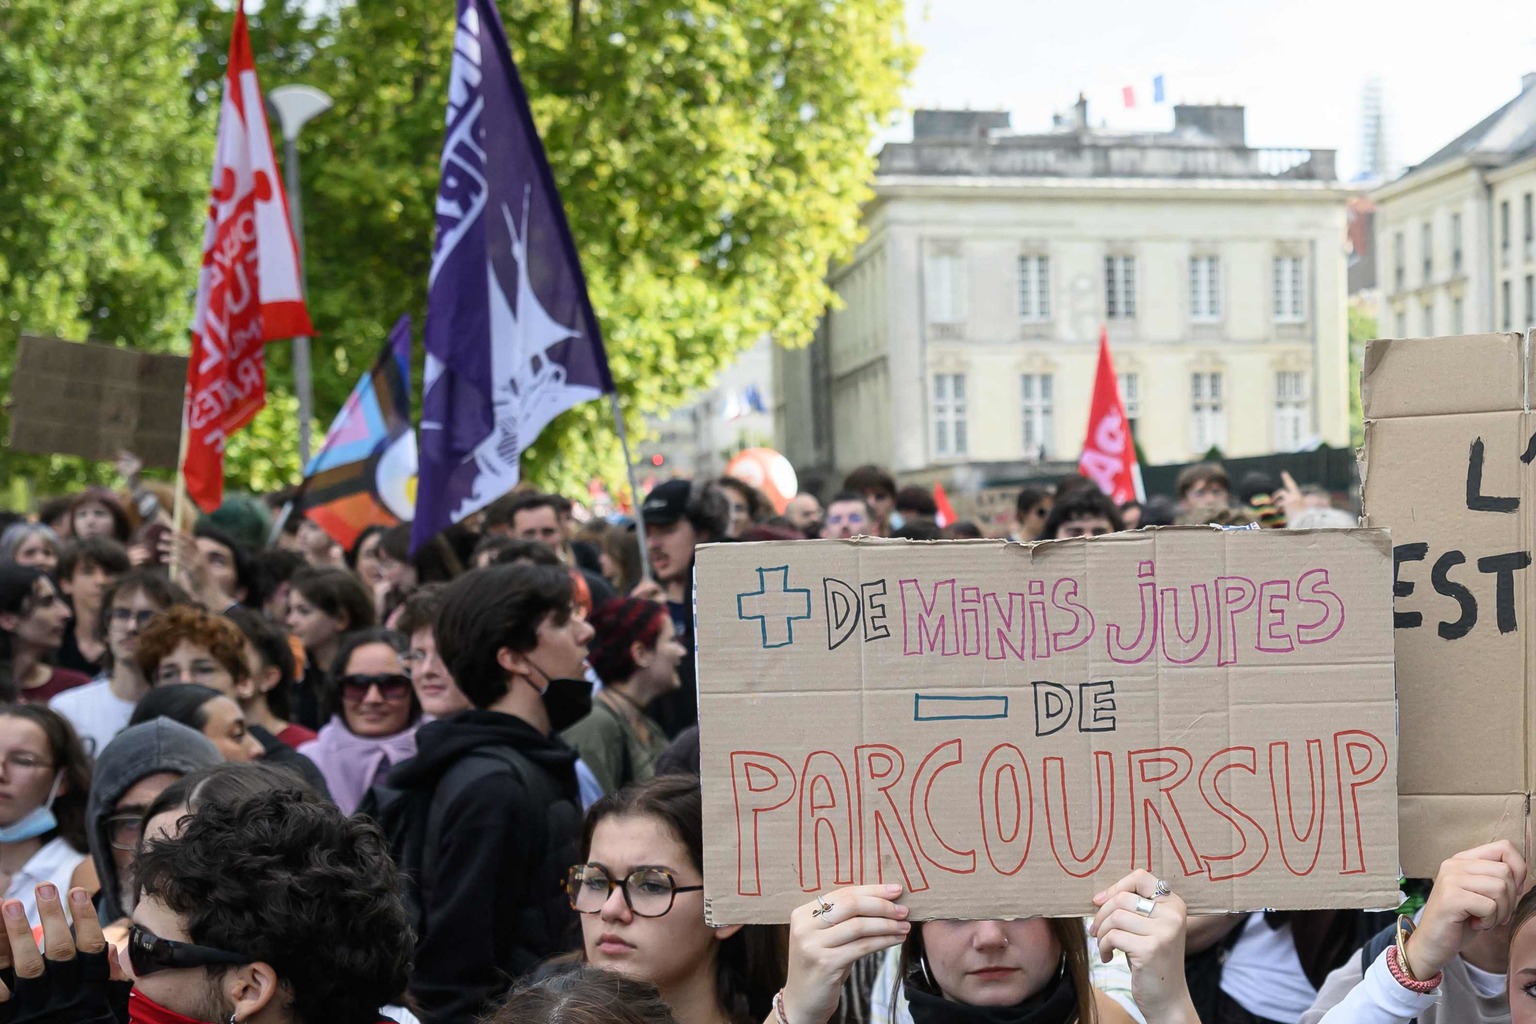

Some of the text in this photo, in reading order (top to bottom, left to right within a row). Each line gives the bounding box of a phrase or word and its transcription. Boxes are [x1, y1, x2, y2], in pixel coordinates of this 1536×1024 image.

[823, 577, 889, 650] DE
[1032, 680, 1116, 736] DE
[730, 729, 1388, 896] PARCOURSUP
